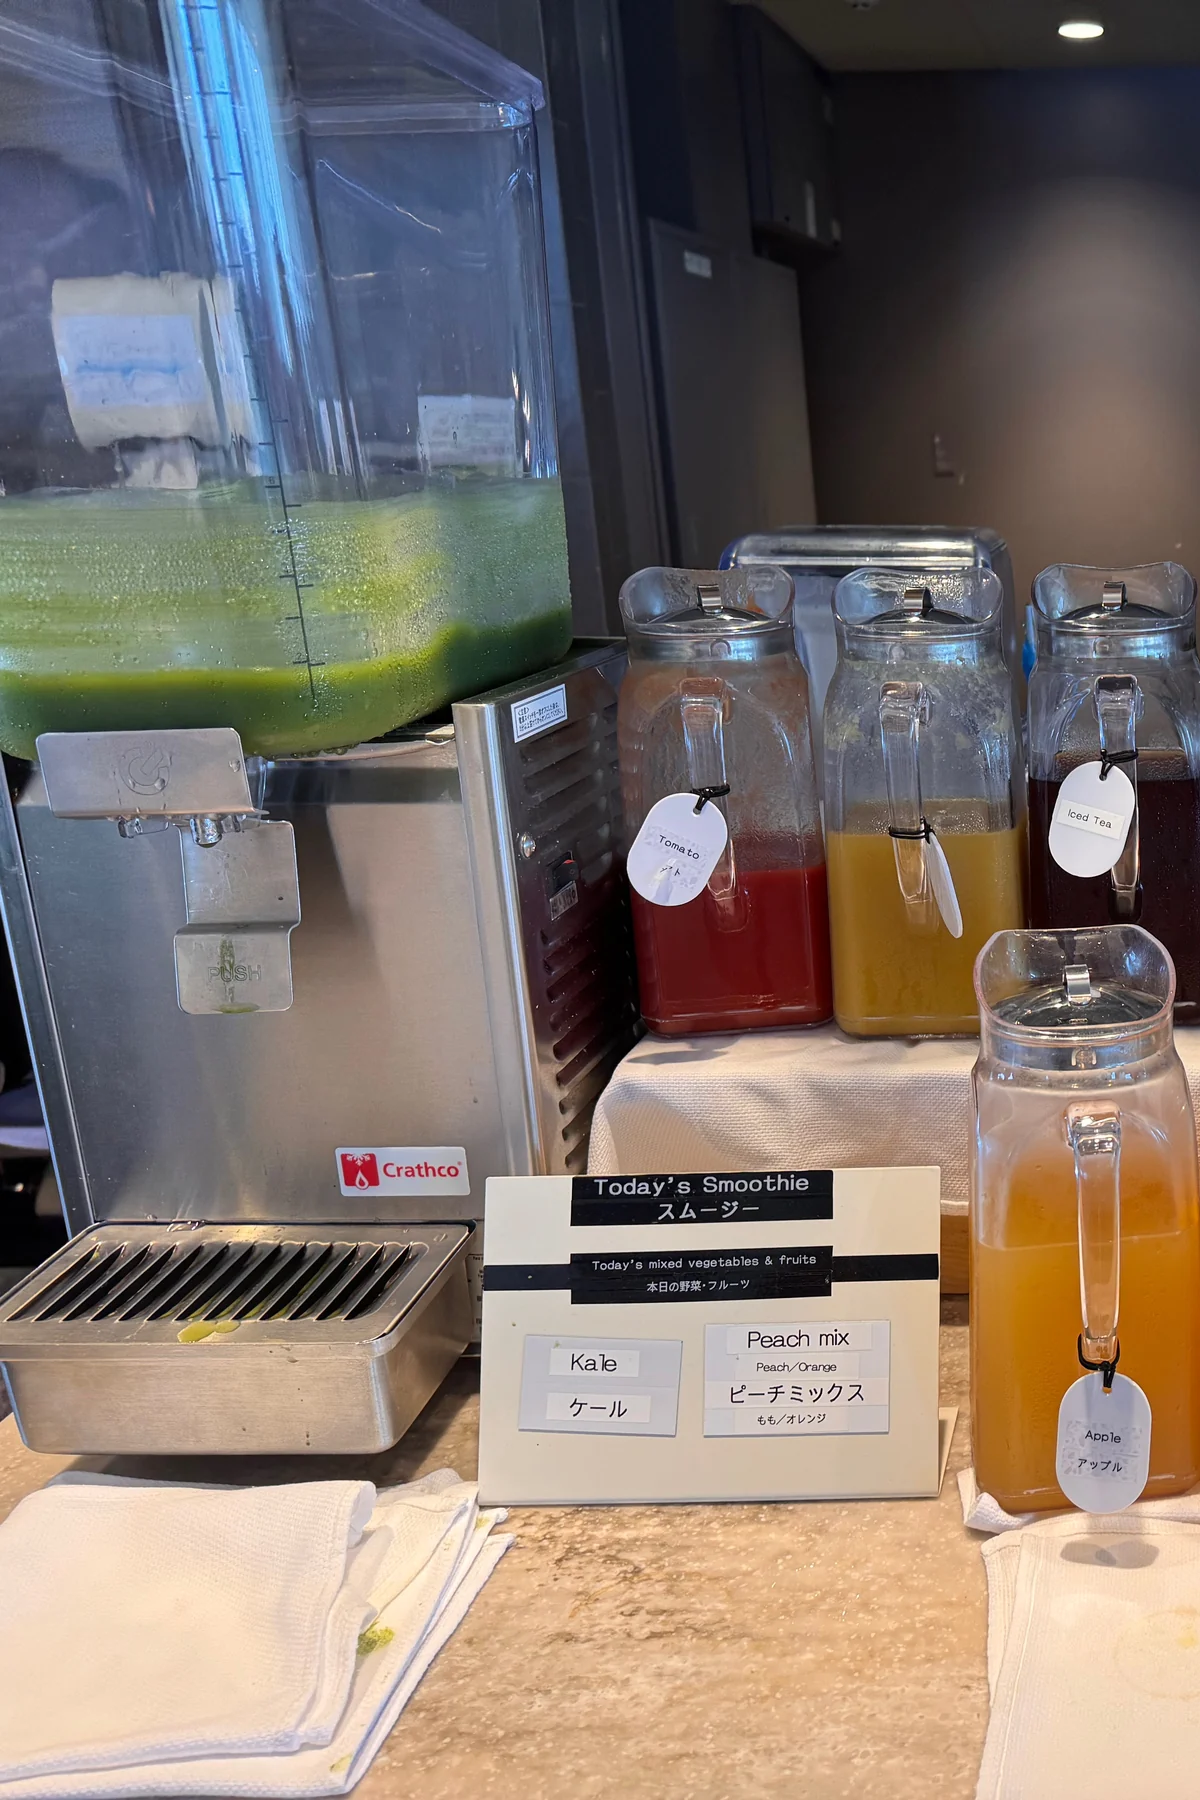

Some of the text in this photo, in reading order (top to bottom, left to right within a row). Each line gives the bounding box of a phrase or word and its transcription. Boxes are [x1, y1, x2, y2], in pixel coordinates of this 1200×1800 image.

[1067, 808, 1112, 829] Iced Tea
[659, 834, 700, 860] Tomato
[207, 964, 262, 983] PUSH
[382, 1161, 460, 1178] Crathco
[593, 1173, 810, 1197] Today's Smoothie
[657, 1200, 760, 1221] スムージー
[591, 1254, 817, 1271] Today's mixed vegetables & fruits
[646, 1279, 750, 1293] 本日の野菜・フルーツ
[748, 1328, 850, 1349] Peach mix
[570, 1352, 618, 1373] Kale
[730, 1382, 865, 1404] ピーチミックス
[569, 1397, 628, 1418] ケール
[1084, 1429, 1122, 1444] Apple
[1078, 1458, 1123, 1473] アップル
